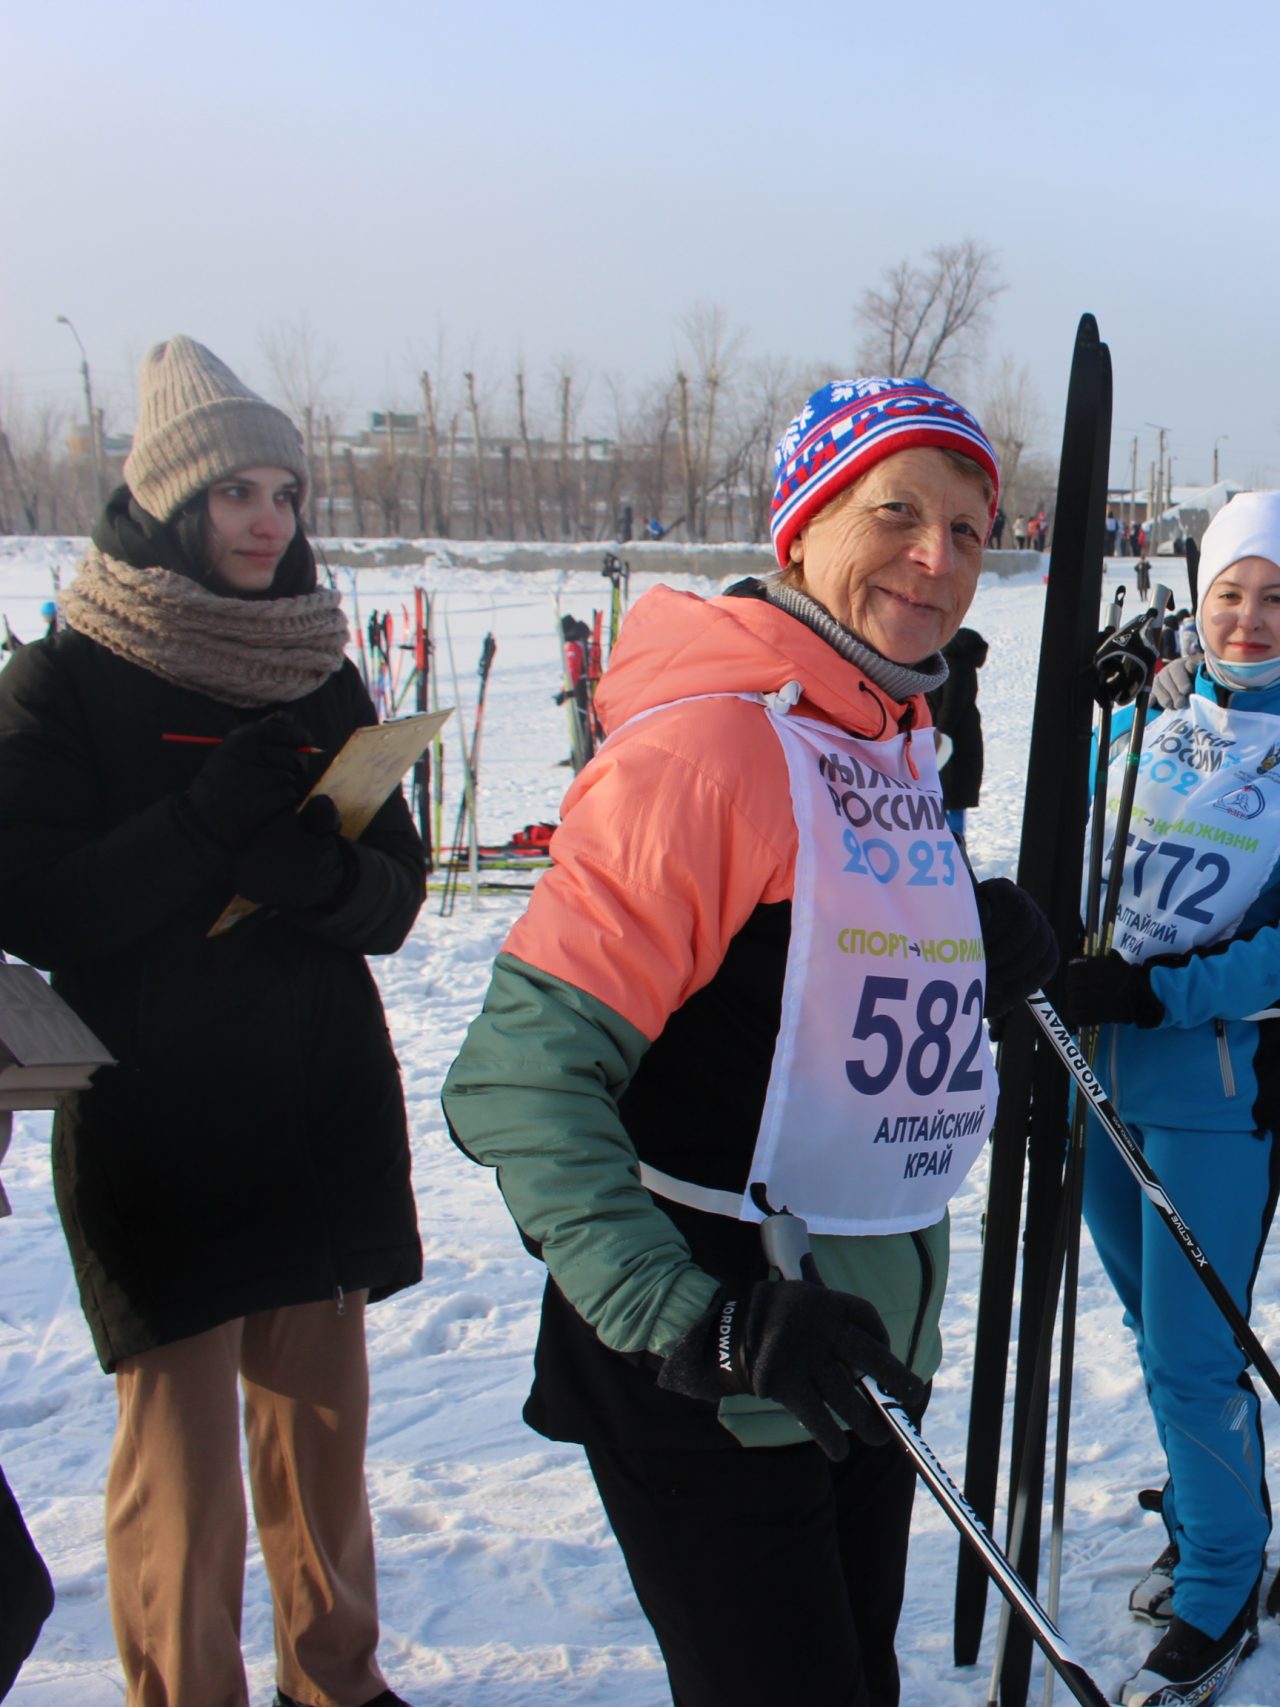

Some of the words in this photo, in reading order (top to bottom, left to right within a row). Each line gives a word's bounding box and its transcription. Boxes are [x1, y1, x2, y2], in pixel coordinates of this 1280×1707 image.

[1196, 822, 1259, 854] ЖИЗНИ
[842, 828, 955, 886] 2023
[837, 928, 909, 959] СПОРТ
[845, 975, 985, 1096] 582
[1041, 1008, 1103, 1097] NORDWAY
[874, 1104, 986, 1144] АЛТАЙСКИЙ
[904, 1149, 952, 1180] КРАЙ
[1170, 1215, 1195, 1247] ACTIVE
[1191, 1246, 1209, 1268] XC
